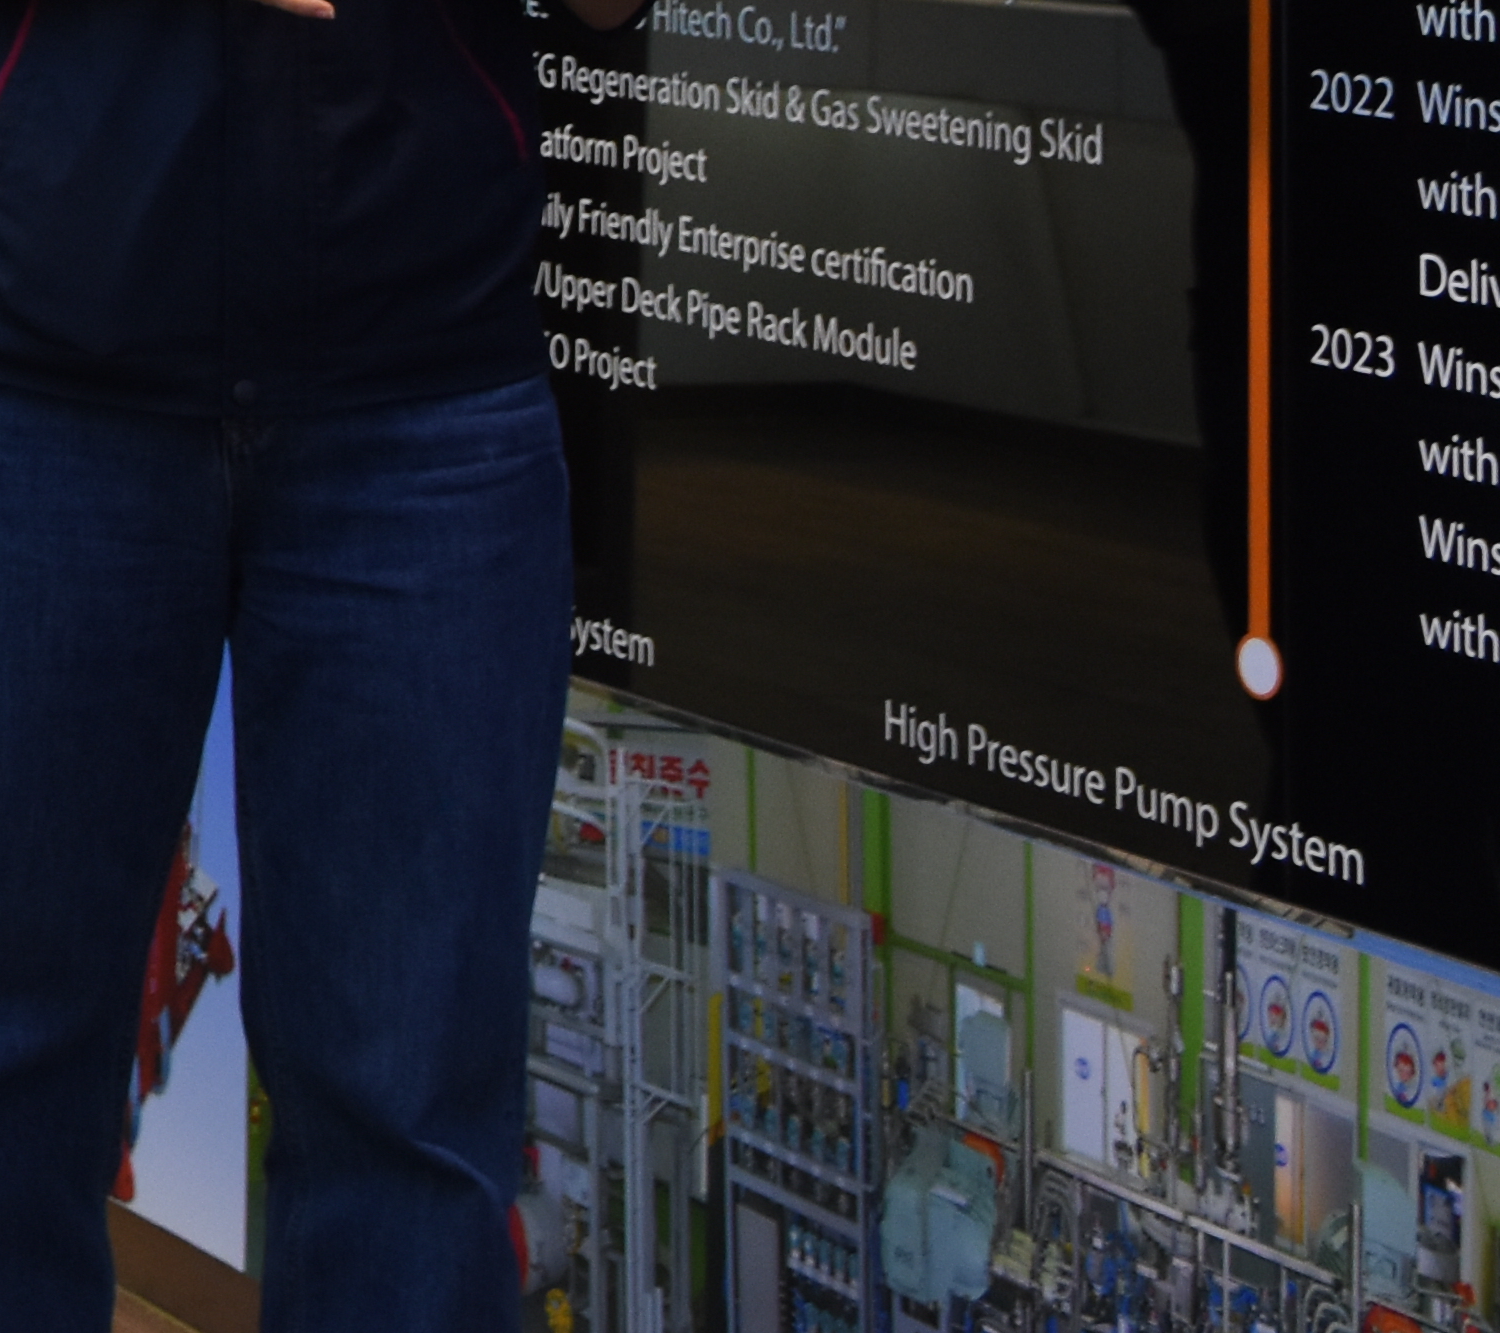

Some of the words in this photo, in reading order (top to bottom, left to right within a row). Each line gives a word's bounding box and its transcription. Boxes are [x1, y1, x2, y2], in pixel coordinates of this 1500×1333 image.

[561, 54, 721, 113] Regeneration
[725, 75, 780, 120] Skid
[785, 84, 806, 124] &
[810, 87, 860, 132] Gas
[866, 94, 1032, 167] Sweetening
[1039, 117, 1103, 166] Skid
[1309, 68, 1394, 120] 2022
[578, 197, 674, 259] Friendly
[678, 214, 806, 274] Enterprise
[810, 245, 974, 304] certification
[621, 275, 682, 324] Deck
[687, 288, 742, 341] Pipe
[747, 300, 808, 350] Rack
[813, 313, 917, 372] Module
[1310, 323, 1395, 378] 2023
[884, 698, 958, 766] High
[967, 723, 1106, 806] Pressure
[1115, 765, 1220, 848] Pump
[1229, 799, 1364, 886] System
